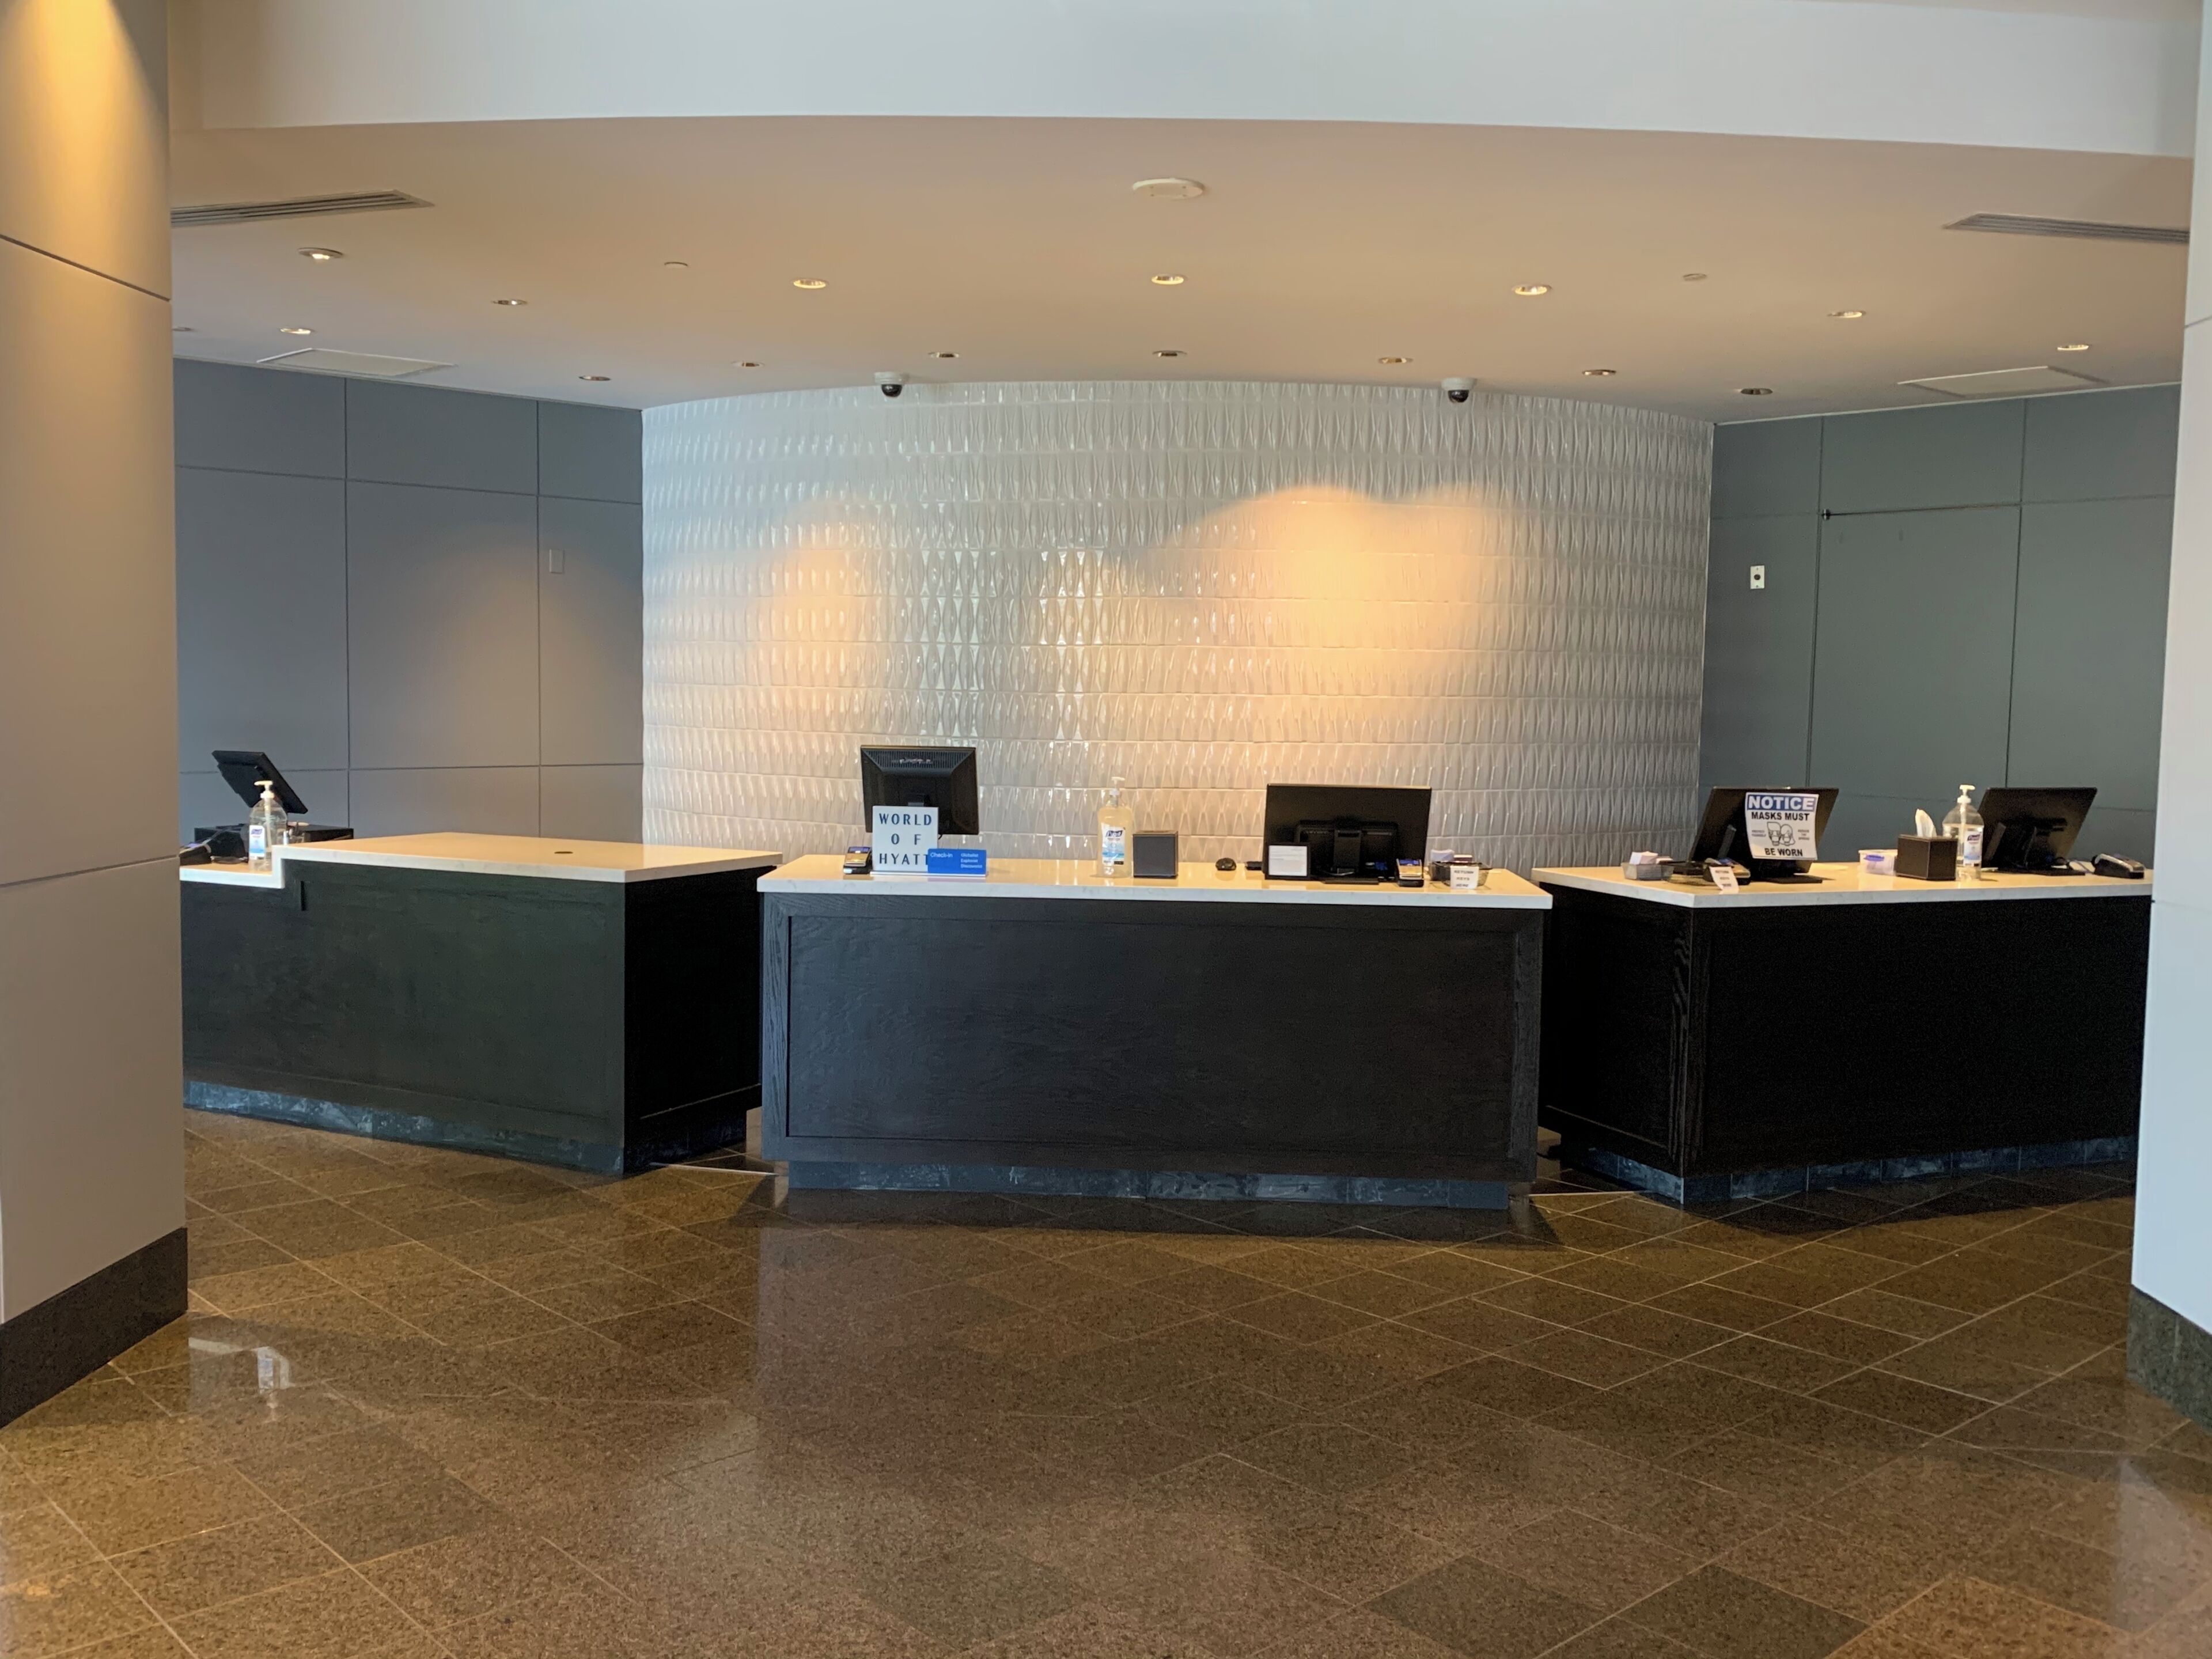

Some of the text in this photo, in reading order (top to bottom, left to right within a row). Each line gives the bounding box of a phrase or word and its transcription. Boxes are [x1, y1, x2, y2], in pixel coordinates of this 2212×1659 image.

[1748, 796, 1815, 810] NOTICE
[879, 813, 931, 825] WORLD
[1751, 812, 1810, 821] MASKS MUST
[1764, 847, 1803, 857] BE WORN
